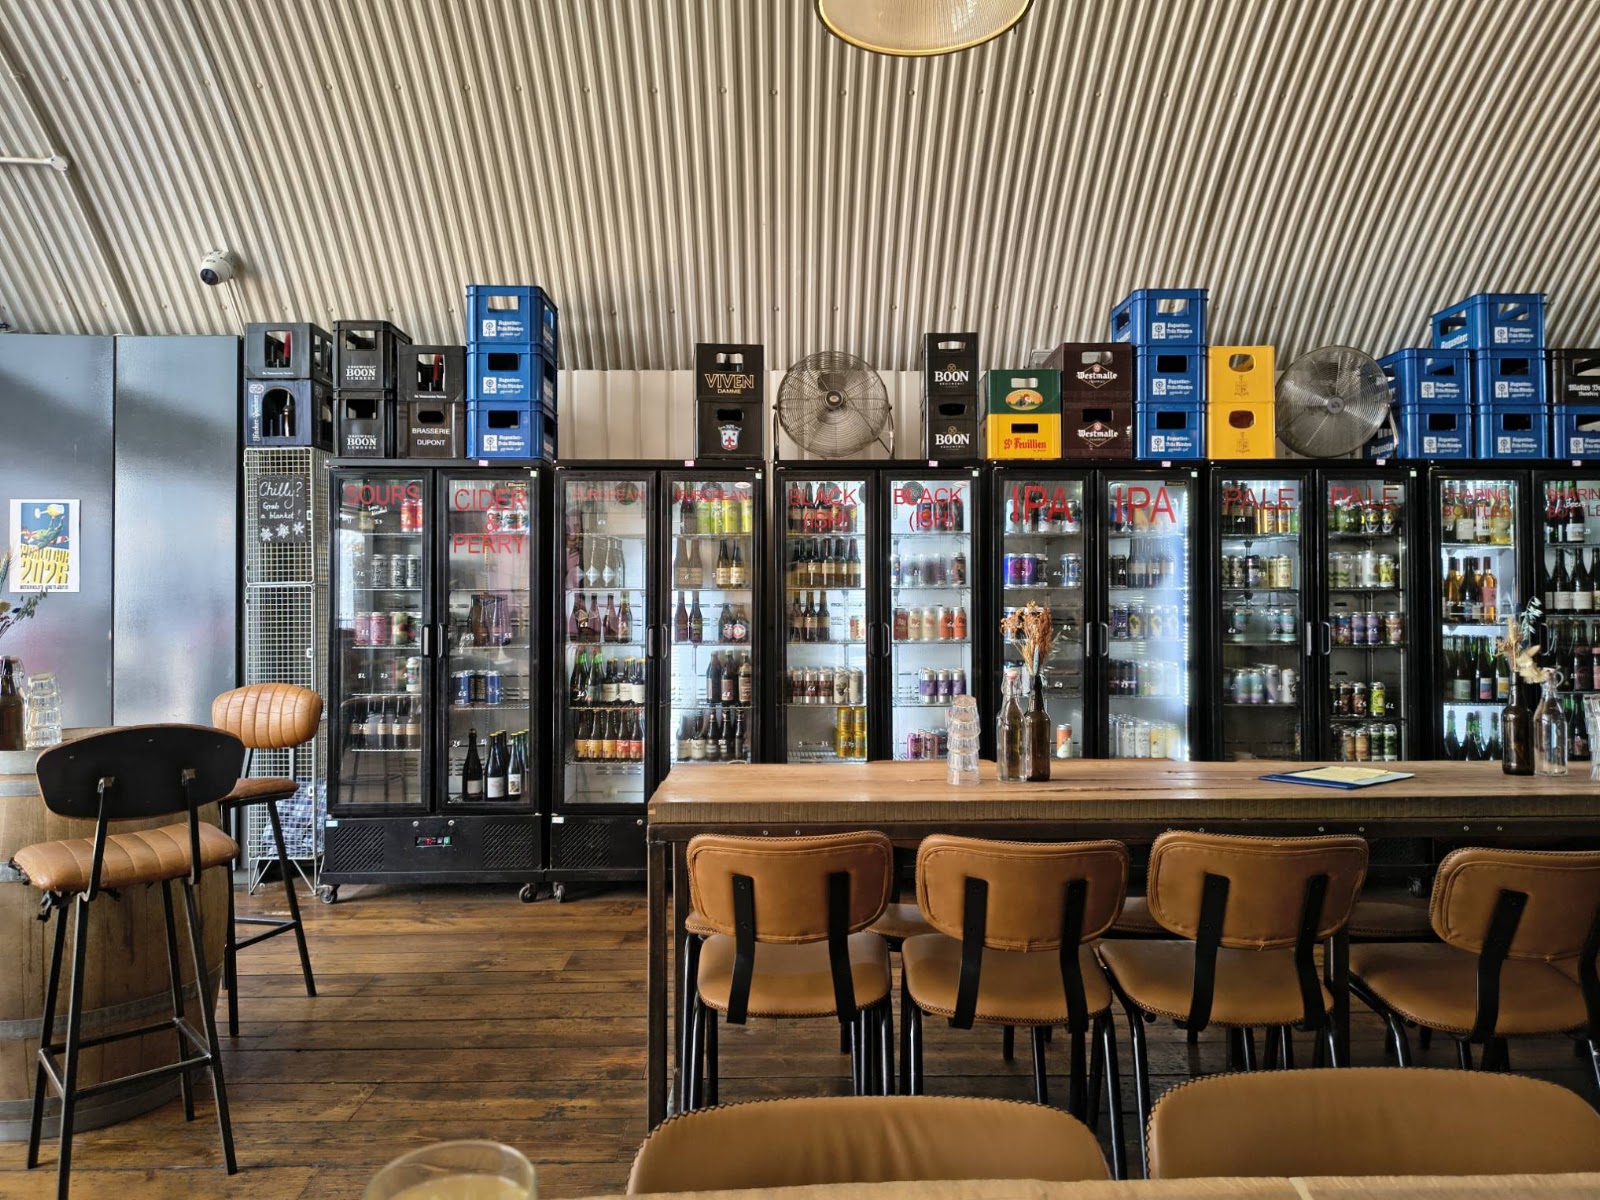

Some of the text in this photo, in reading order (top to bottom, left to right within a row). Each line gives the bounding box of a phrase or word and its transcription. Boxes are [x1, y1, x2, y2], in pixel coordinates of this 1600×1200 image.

[346, 369, 376, 377] BOON
[934, 370, 970, 382] BOON
[1076, 371, 1118, 380] Westmalle
[704, 374, 754, 388] VIVEN
[935, 434, 970, 445] BOON
[1078, 429, 1119, 438] Westmalle
[347, 438, 377, 446] BOON
[1014, 437, 1046, 450] Feuillien
[260, 481, 302, 509] Chilly?
[344, 484, 420, 506] SOURS
[454, 489, 527, 511] CIDER
[572, 488, 644, 501] EUROPEAN
[675, 489, 748, 502] EUROPEAN
[788, 488, 856, 506] BLACK
[894, 487, 962, 505] BLACK
[1224, 488, 1295, 511] PALE
[1330, 486, 1399, 512] PALE
[1443, 488, 1510, 501] SHARING
[1546, 488, 1600, 502] SHARIN
[263, 502, 280, 511] Grab
[1012, 484, 1074, 524] IPA
[1116, 486, 1176, 524] IPA
[1442, 504, 1512, 518] BOTTLES
[1547, 505, 1600, 518] BOTTLE
[485, 513, 500, 532] &
[802, 511, 848, 532] (ISH)
[909, 511, 955, 532] (ISH)
[453, 534, 527, 554] PERRY
[20, 560, 70, 584] 2026
